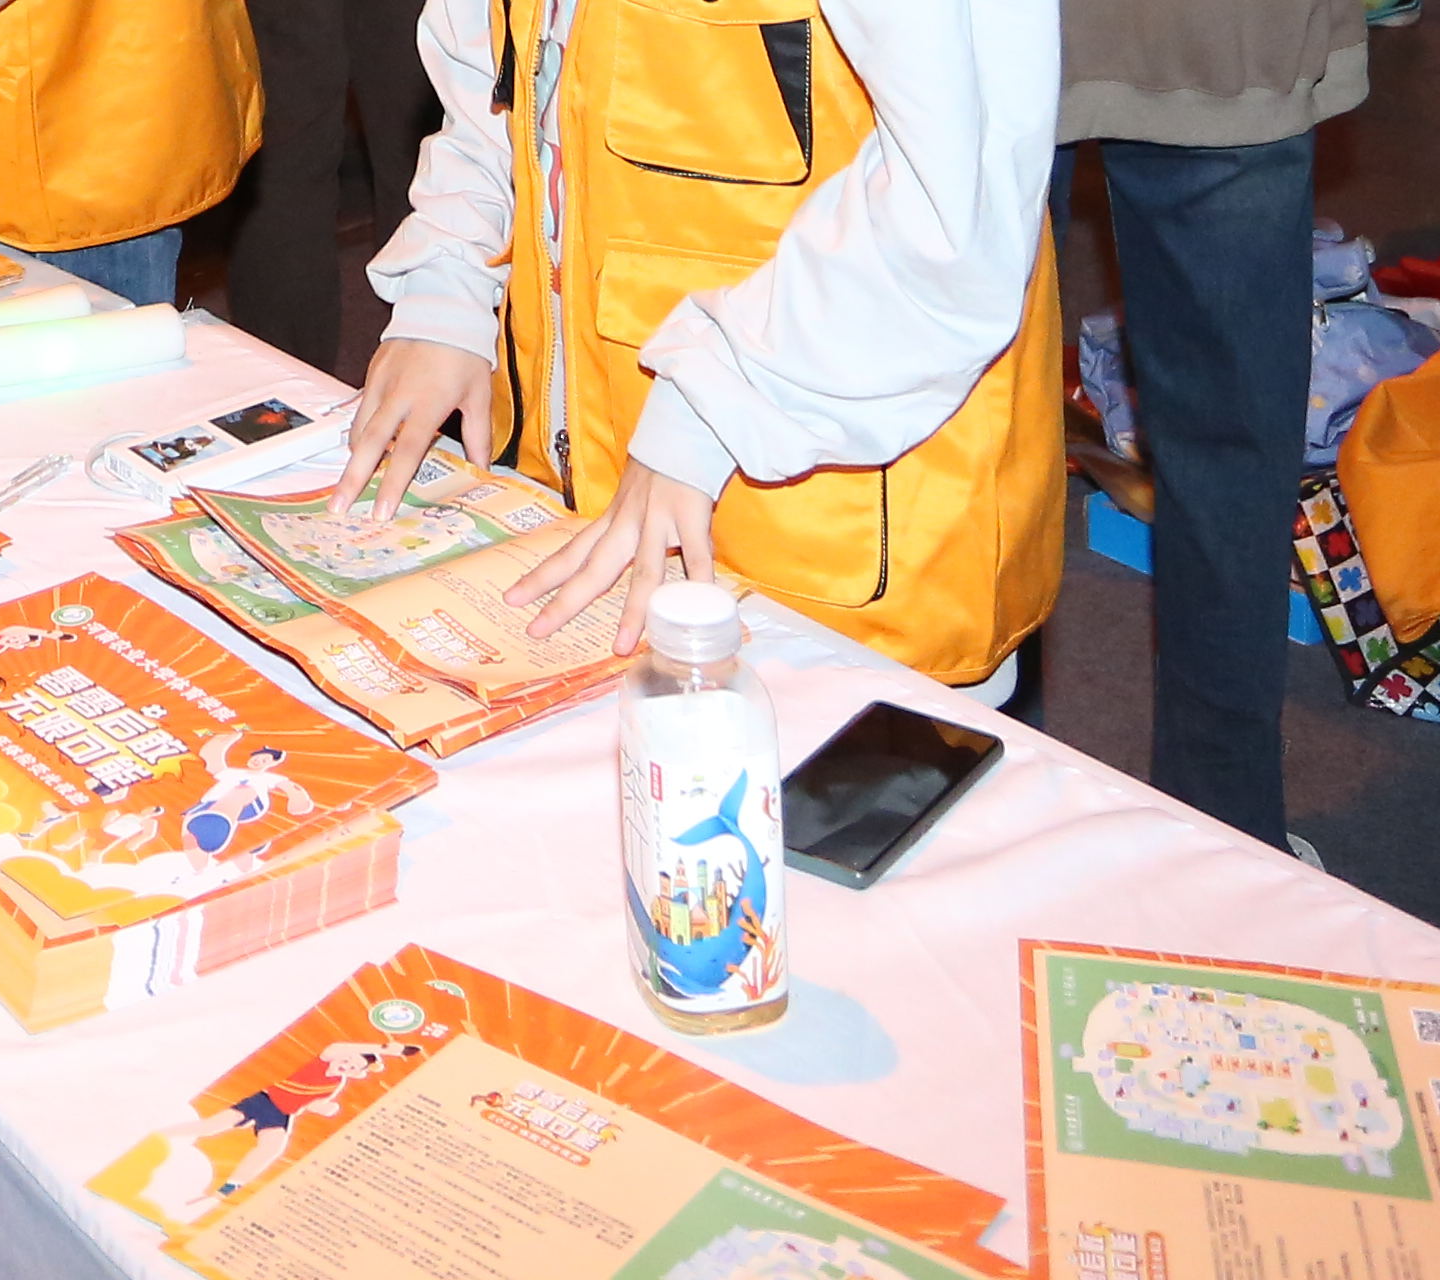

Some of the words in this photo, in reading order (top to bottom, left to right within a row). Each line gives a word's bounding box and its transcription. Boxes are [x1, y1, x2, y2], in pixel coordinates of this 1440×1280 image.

[35, 665, 190, 765] 零零后敢
[82, 621, 237, 722] 河南农业大学体育学院
